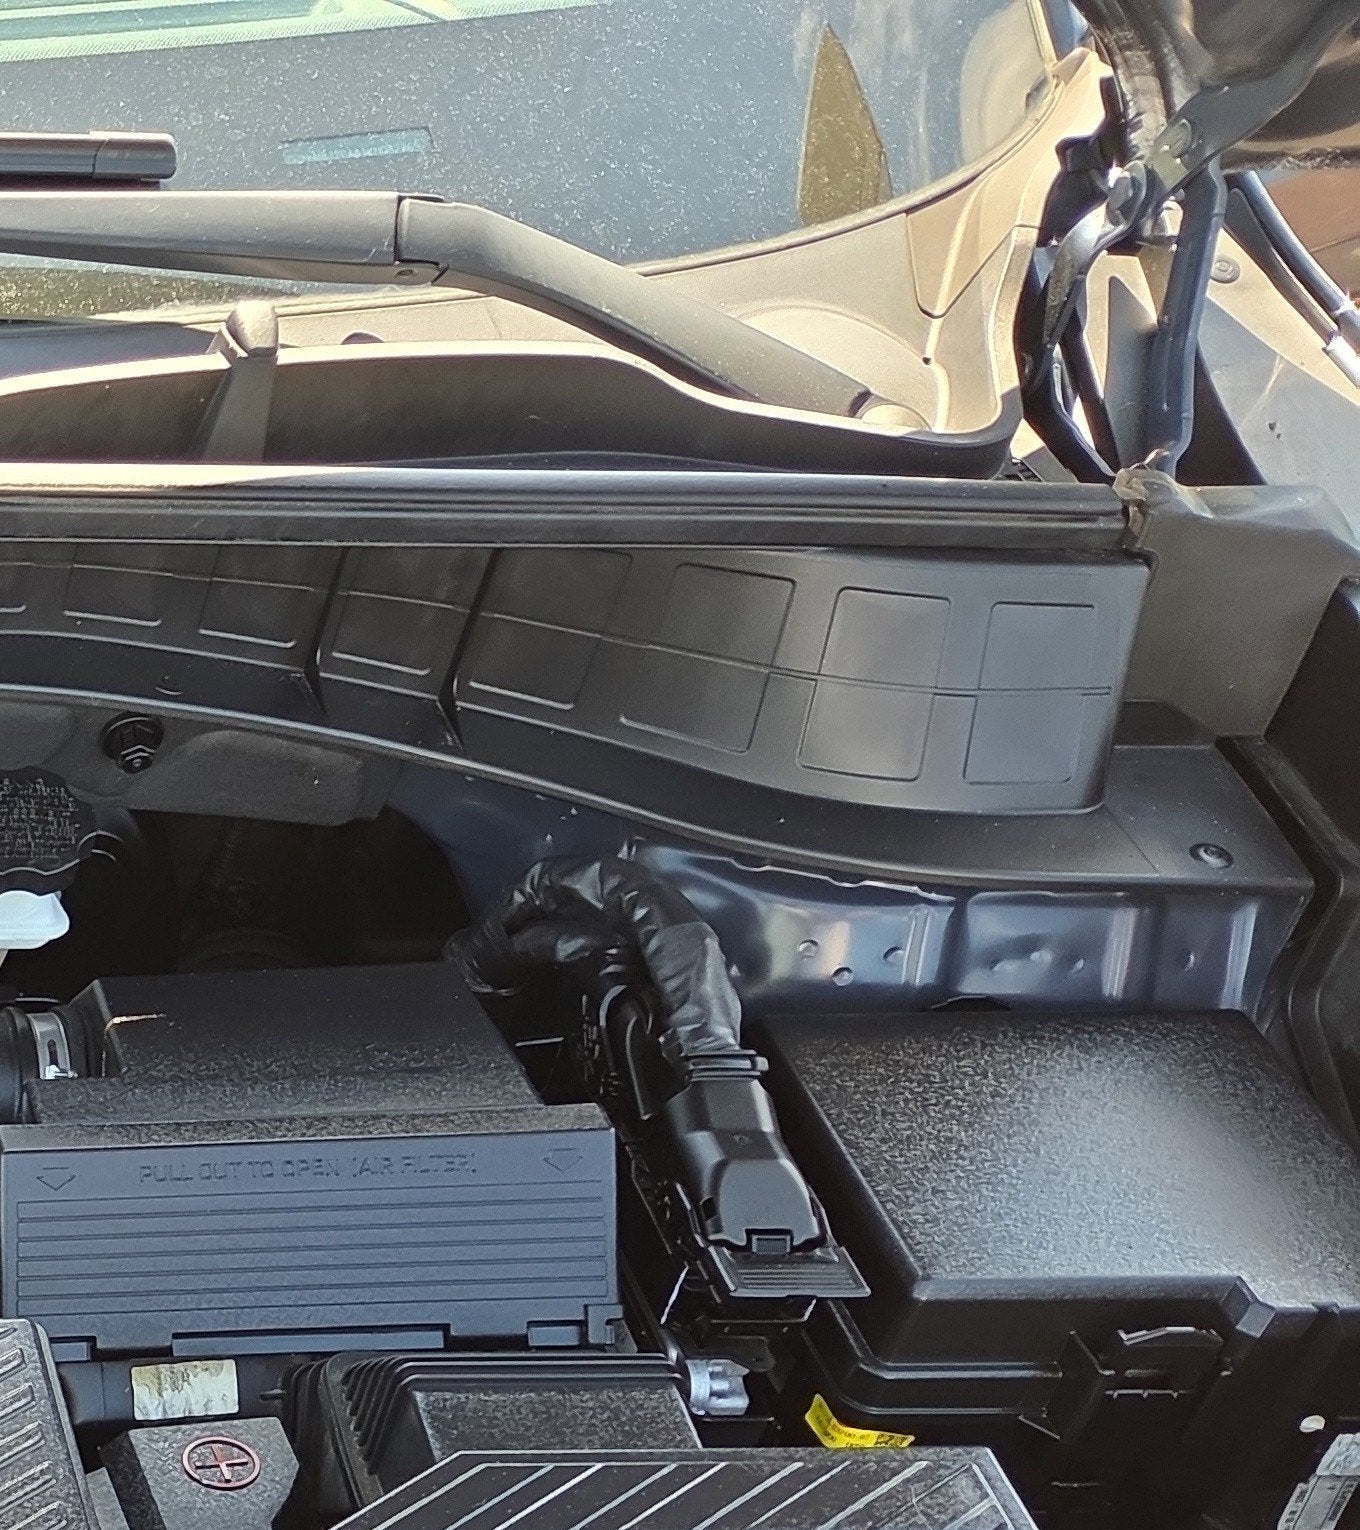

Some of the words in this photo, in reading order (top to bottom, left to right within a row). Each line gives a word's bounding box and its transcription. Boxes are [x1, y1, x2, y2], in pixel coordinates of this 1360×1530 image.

[139, 1163, 194, 1183] PULL
[199, 1160, 243, 1180] OUT
[246, 1158, 275, 1178] TO
[282, 1155, 340, 1177] OPEN
